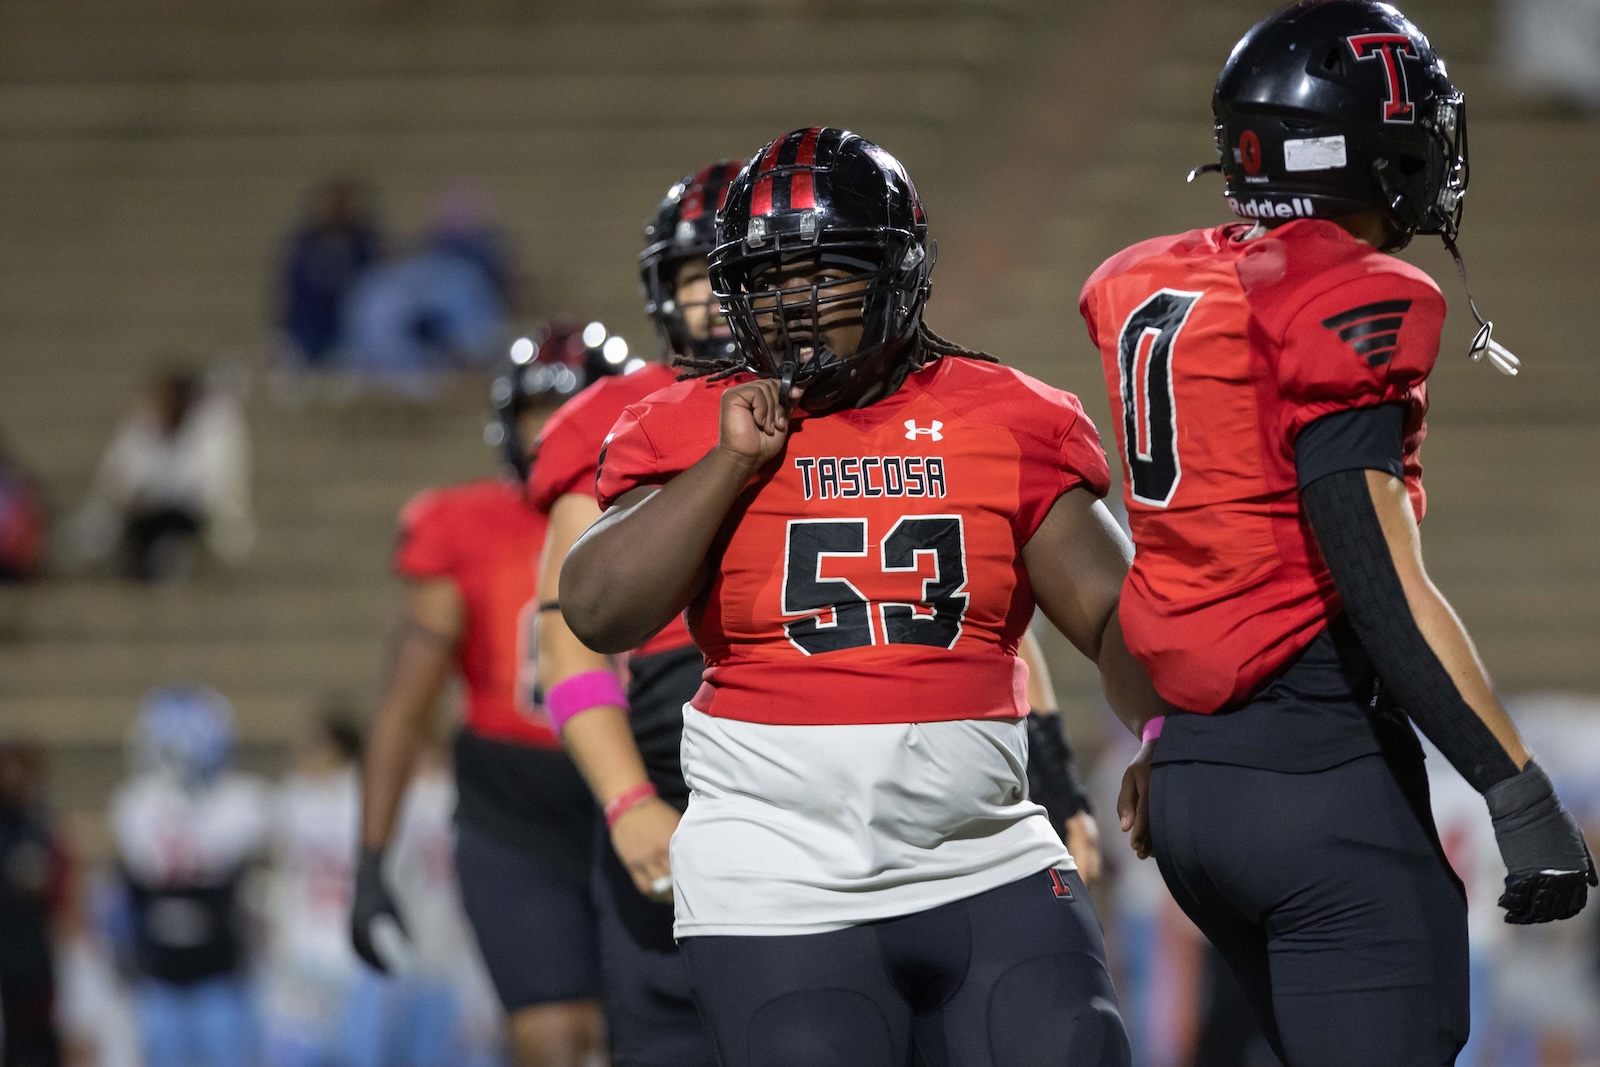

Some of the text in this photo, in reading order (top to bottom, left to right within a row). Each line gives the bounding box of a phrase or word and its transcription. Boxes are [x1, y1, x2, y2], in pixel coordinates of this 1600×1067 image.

[1347, 33, 1420, 124] T
[1227, 198, 1315, 218] Riddell
[1117, 287, 1204, 508] 0
[795, 456, 946, 500] TASCOSA
[781, 514, 970, 656] 53
